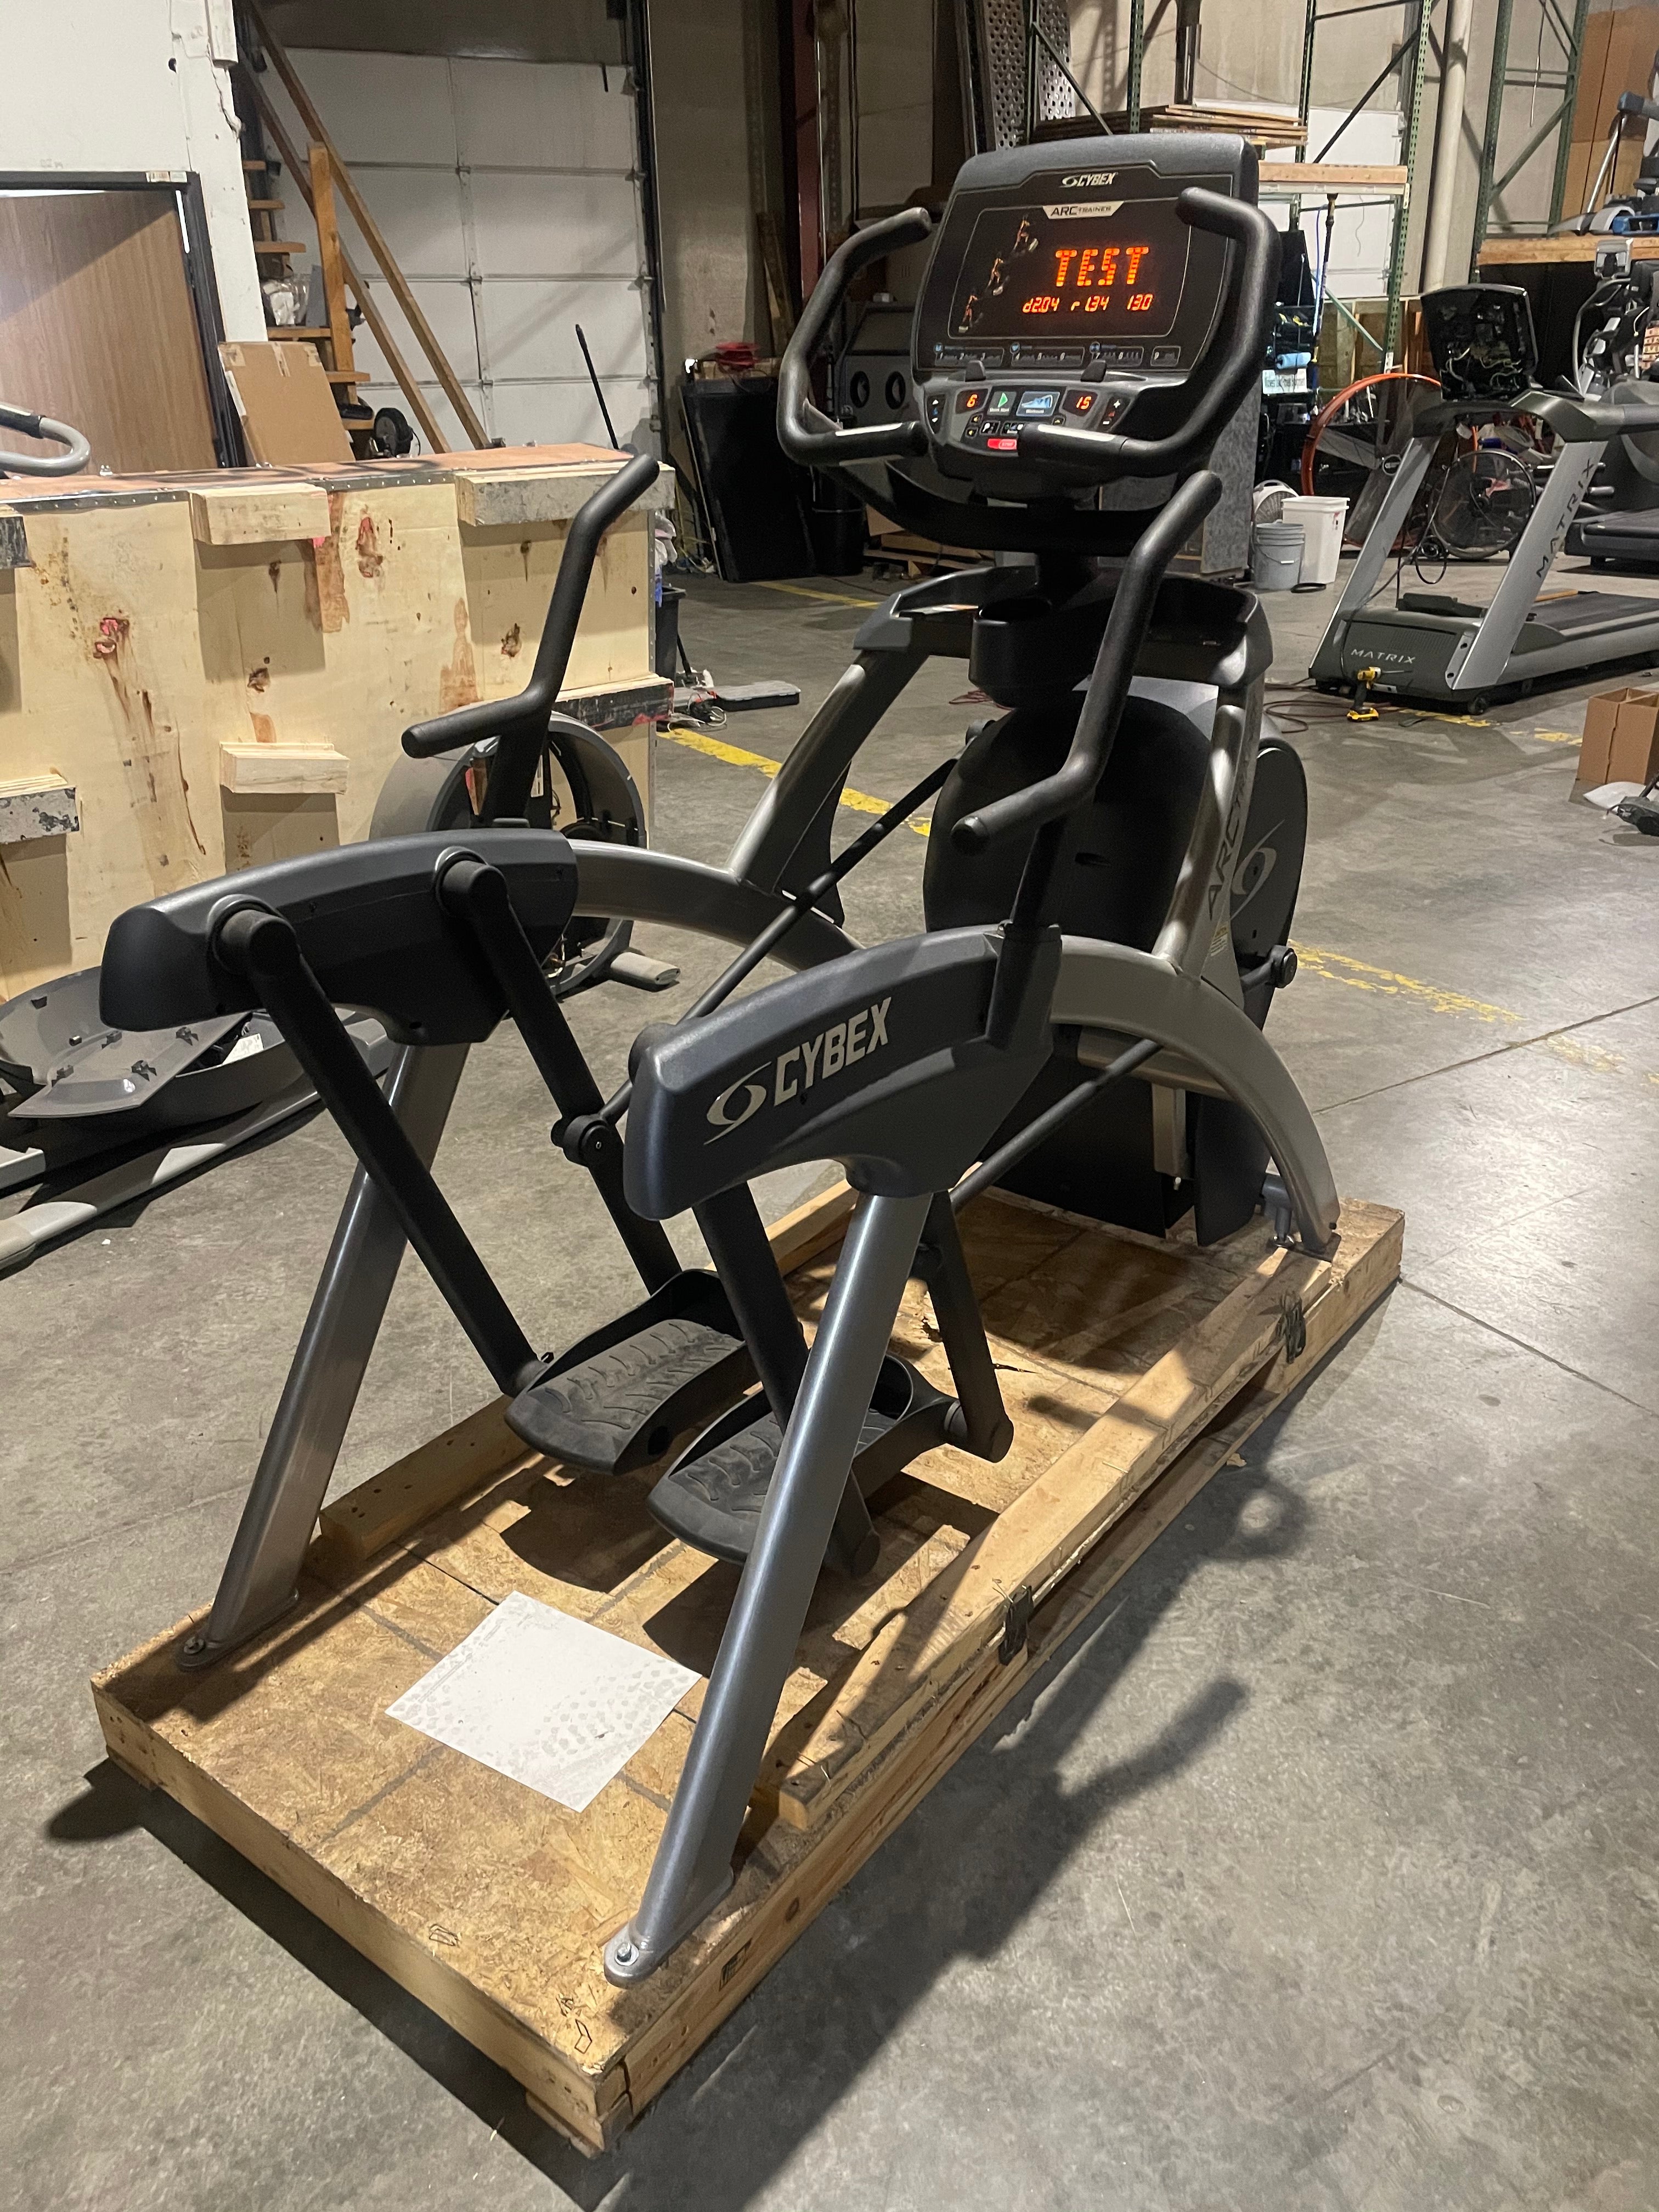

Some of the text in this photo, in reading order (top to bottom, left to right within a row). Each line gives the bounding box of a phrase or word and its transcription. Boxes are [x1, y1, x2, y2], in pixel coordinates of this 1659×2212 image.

[1076, 172, 1116, 187] CYBEX
[1050, 206, 1111, 217] ARC TRAINER
[1055, 246, 1149, 287] TEST
[1126, 294, 1153, 311] 130
[967, 393, 978, 408] 6
[1076, 396, 1092, 410] 15
[1536, 458, 1594, 578] MATRIX
[1351, 648, 1415, 664] MATRIX
[774, 996, 891, 1107] CYBEX
